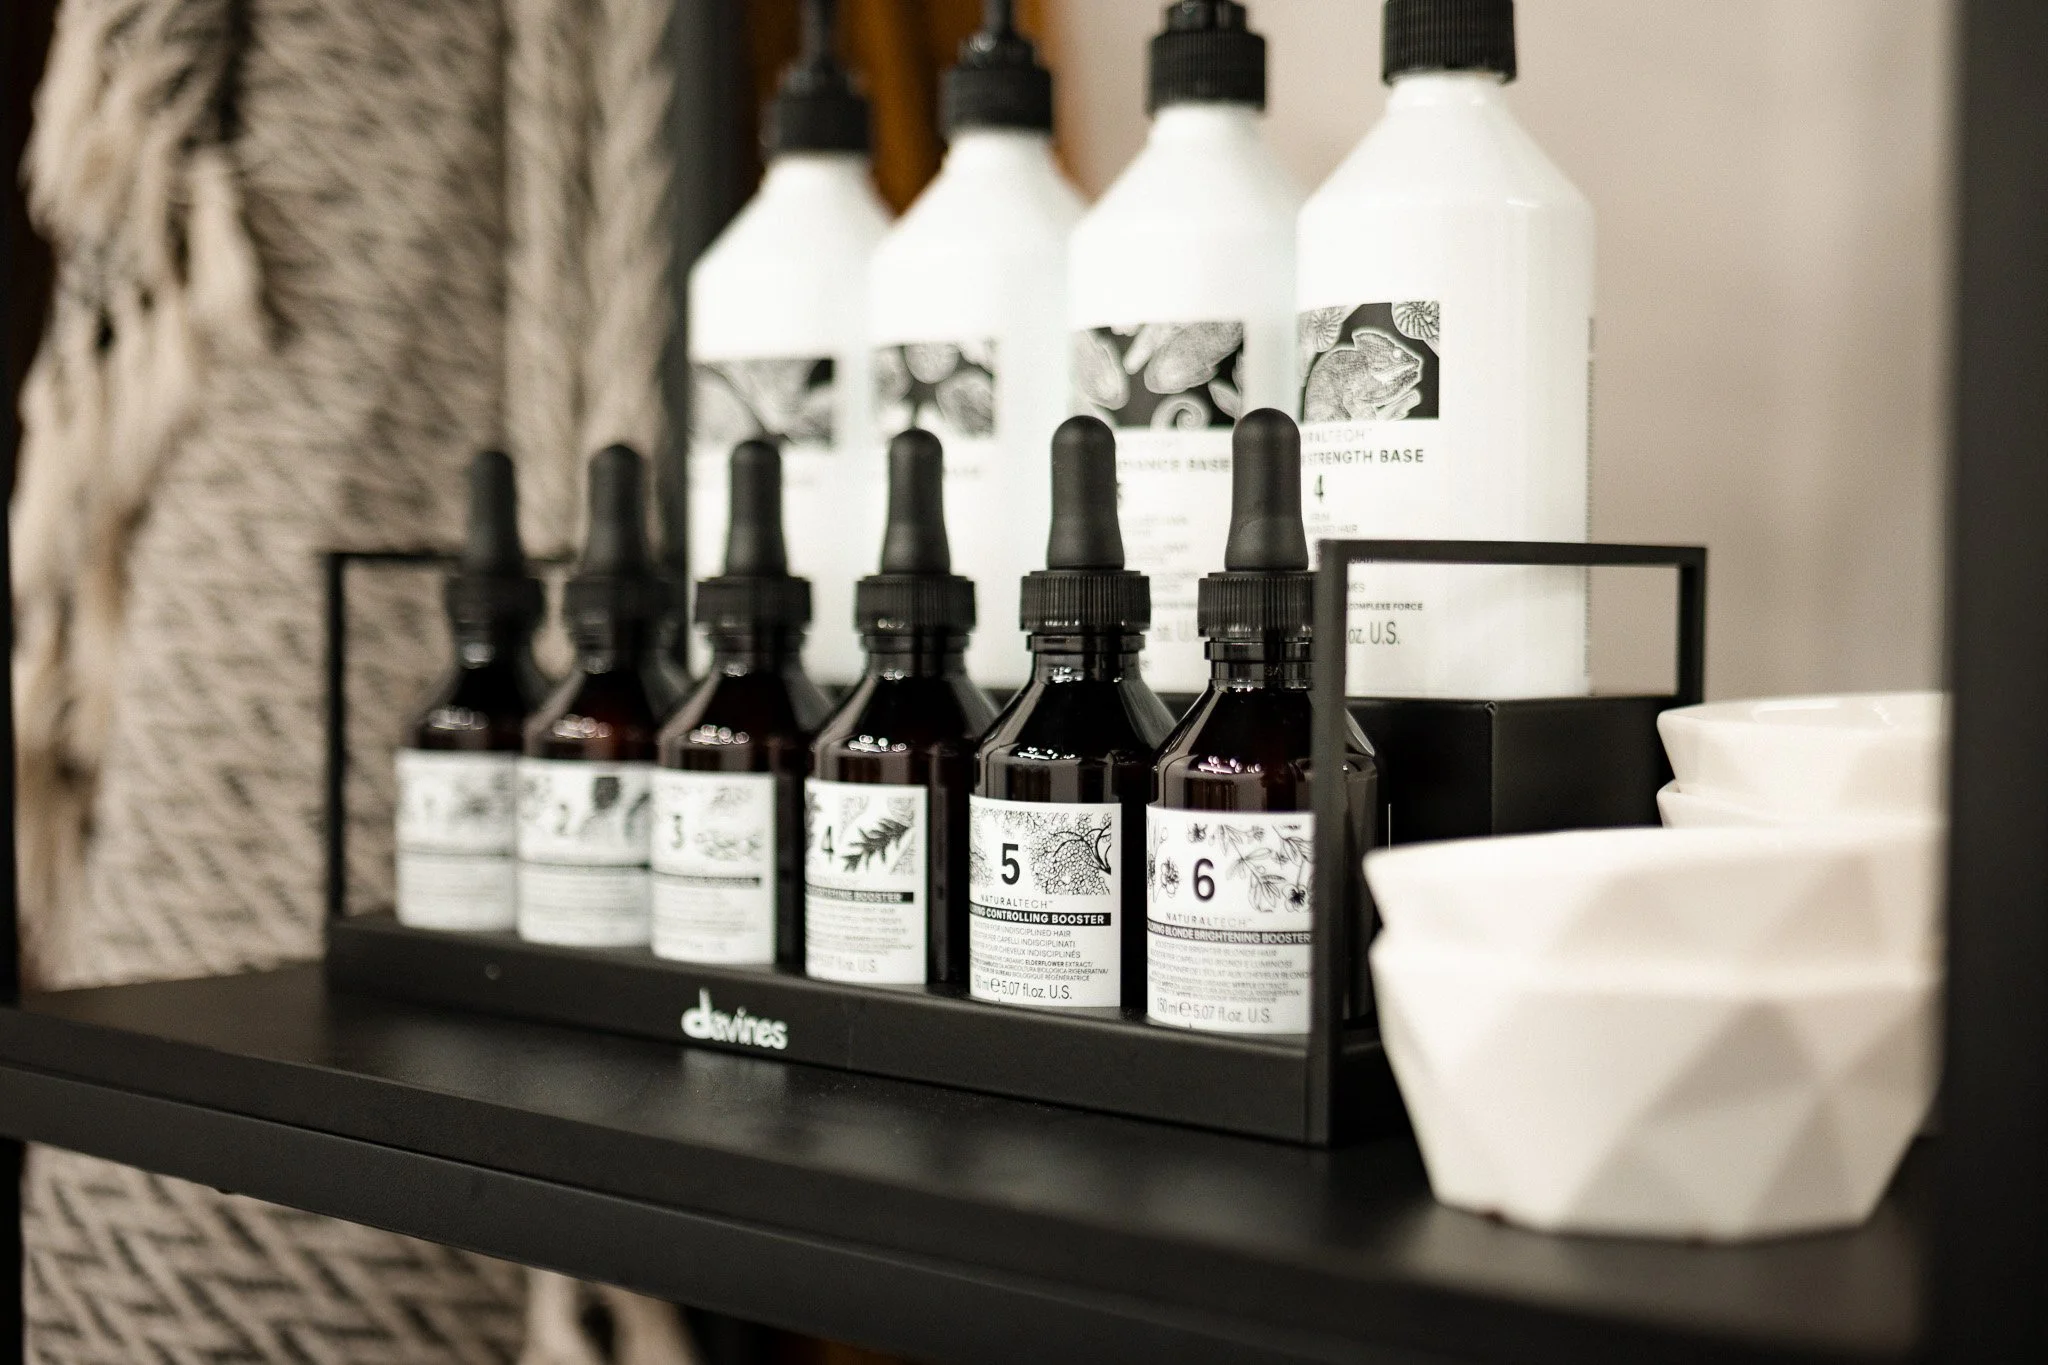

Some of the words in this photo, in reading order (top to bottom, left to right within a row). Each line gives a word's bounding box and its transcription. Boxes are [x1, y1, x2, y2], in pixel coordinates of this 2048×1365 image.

[1306, 449, 1372, 465] STRENGTH
[1380, 449, 1424, 463] BASE
[1314, 474, 1324, 503] 4
[1370, 622, 1400, 645] U.S.
[821, 825, 834, 864] 4
[1002, 843, 1020, 885] 5
[1193, 858, 1215, 902] 6
[986, 908, 1048, 923] CONTROLLING
[1052, 915, 1104, 924] BOOSTER
[1001, 926, 1051, 937] INDISCIPLINED
[1165, 926, 1194, 939] BLONDE
[1194, 929, 1260, 943] BRIGHTENING
[1261, 934, 1309, 943] BOOSTER
[1021, 938, 1075, 948] INDISCIPLINATI
[1027, 948, 1081, 958] INDISCIPLINÉS
[1025, 959, 1064, 967] ELDERFLOWER
[1049, 985, 1072, 999] U.S.
[681, 987, 788, 1050] davines
[1248, 1008, 1272, 1024] U.S.
